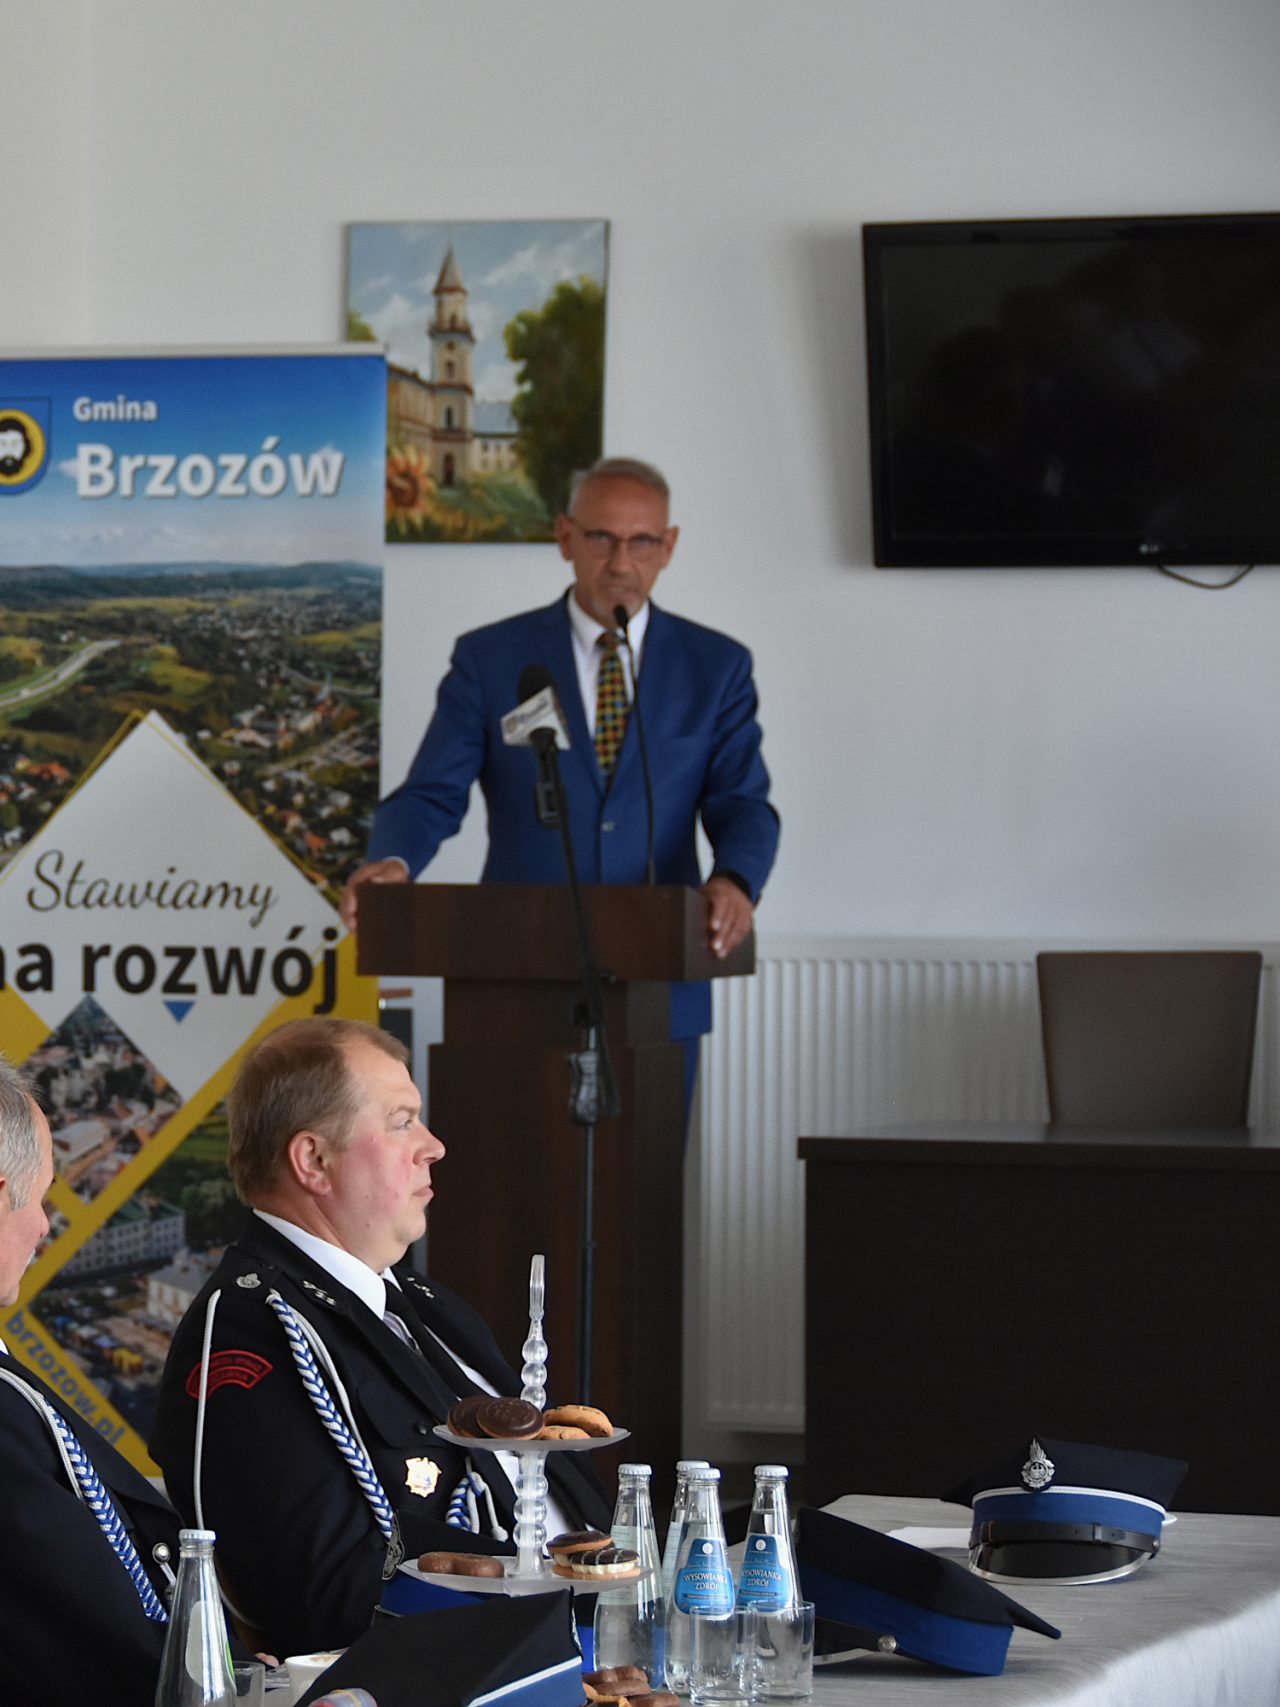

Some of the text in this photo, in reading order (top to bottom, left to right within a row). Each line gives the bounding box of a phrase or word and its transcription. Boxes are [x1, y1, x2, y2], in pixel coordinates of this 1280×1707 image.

[73, 395, 158, 422] Gmina
[76, 436, 346, 498] Brzozów
[27, 849, 278, 928] Stawiamy
[82, 926, 339, 1015] rozwój
[6, 1310, 126, 1445] brzozow.pl
